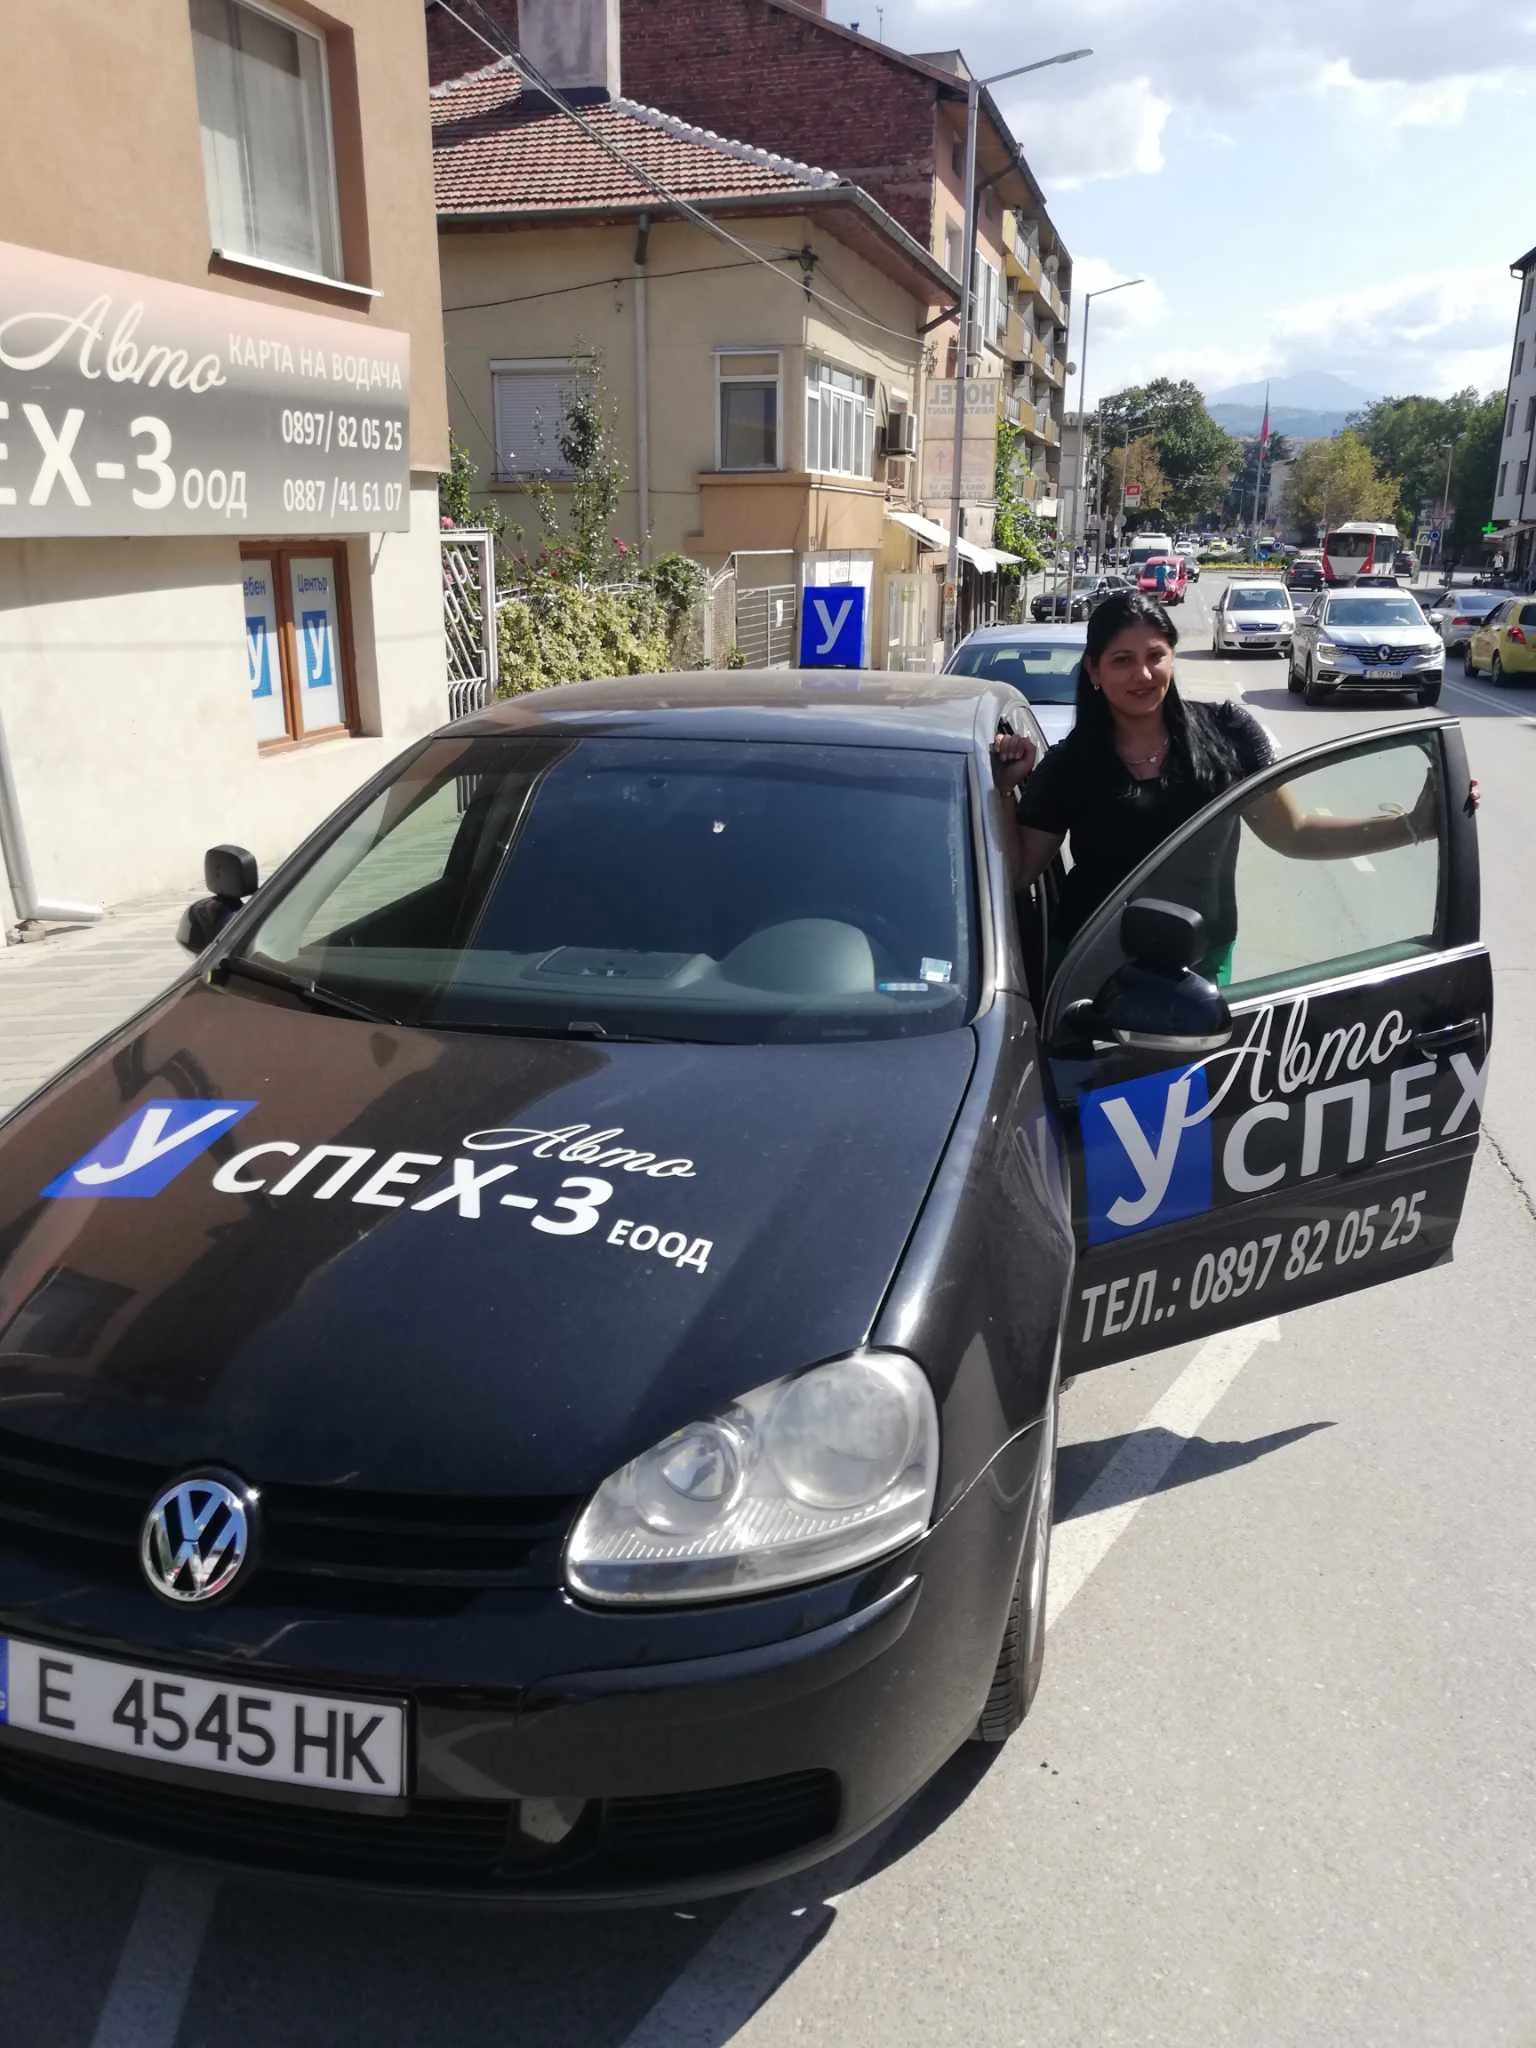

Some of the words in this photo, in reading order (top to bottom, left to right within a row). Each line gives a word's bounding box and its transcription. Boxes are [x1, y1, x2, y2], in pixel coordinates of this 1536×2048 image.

[0, 295, 227, 393] Авто
[229, 333, 295, 375] КАРТА
[301, 348, 328, 380] НА
[333, 352, 402, 392] ВОДАЧА
[282, 409, 334, 453] 0897/
[338, 415, 358, 448] 82
[361, 417, 381, 450] 05
[384, 420, 402, 451] 25
[183, 468, 247, 519] ООД
[283, 478, 325, 512] 0887
[362, 481, 381, 512] 61
[384, 483, 402, 512] 07
[1178, 995, 1411, 1128] Авто
[462, 1124, 697, 1177] Авто
[606, 1219, 714, 1274] ЕООД
[1081, 1270, 1181, 1343] ТЕЛ.:
[1189, 1234, 1283, 1311] 0897
[1283, 1219, 1331, 1281] 82
[1334, 1206, 1380, 1265] 05
[1380, 1190, 1427, 1252] 25
[112, 1678, 276, 1768] 4545
